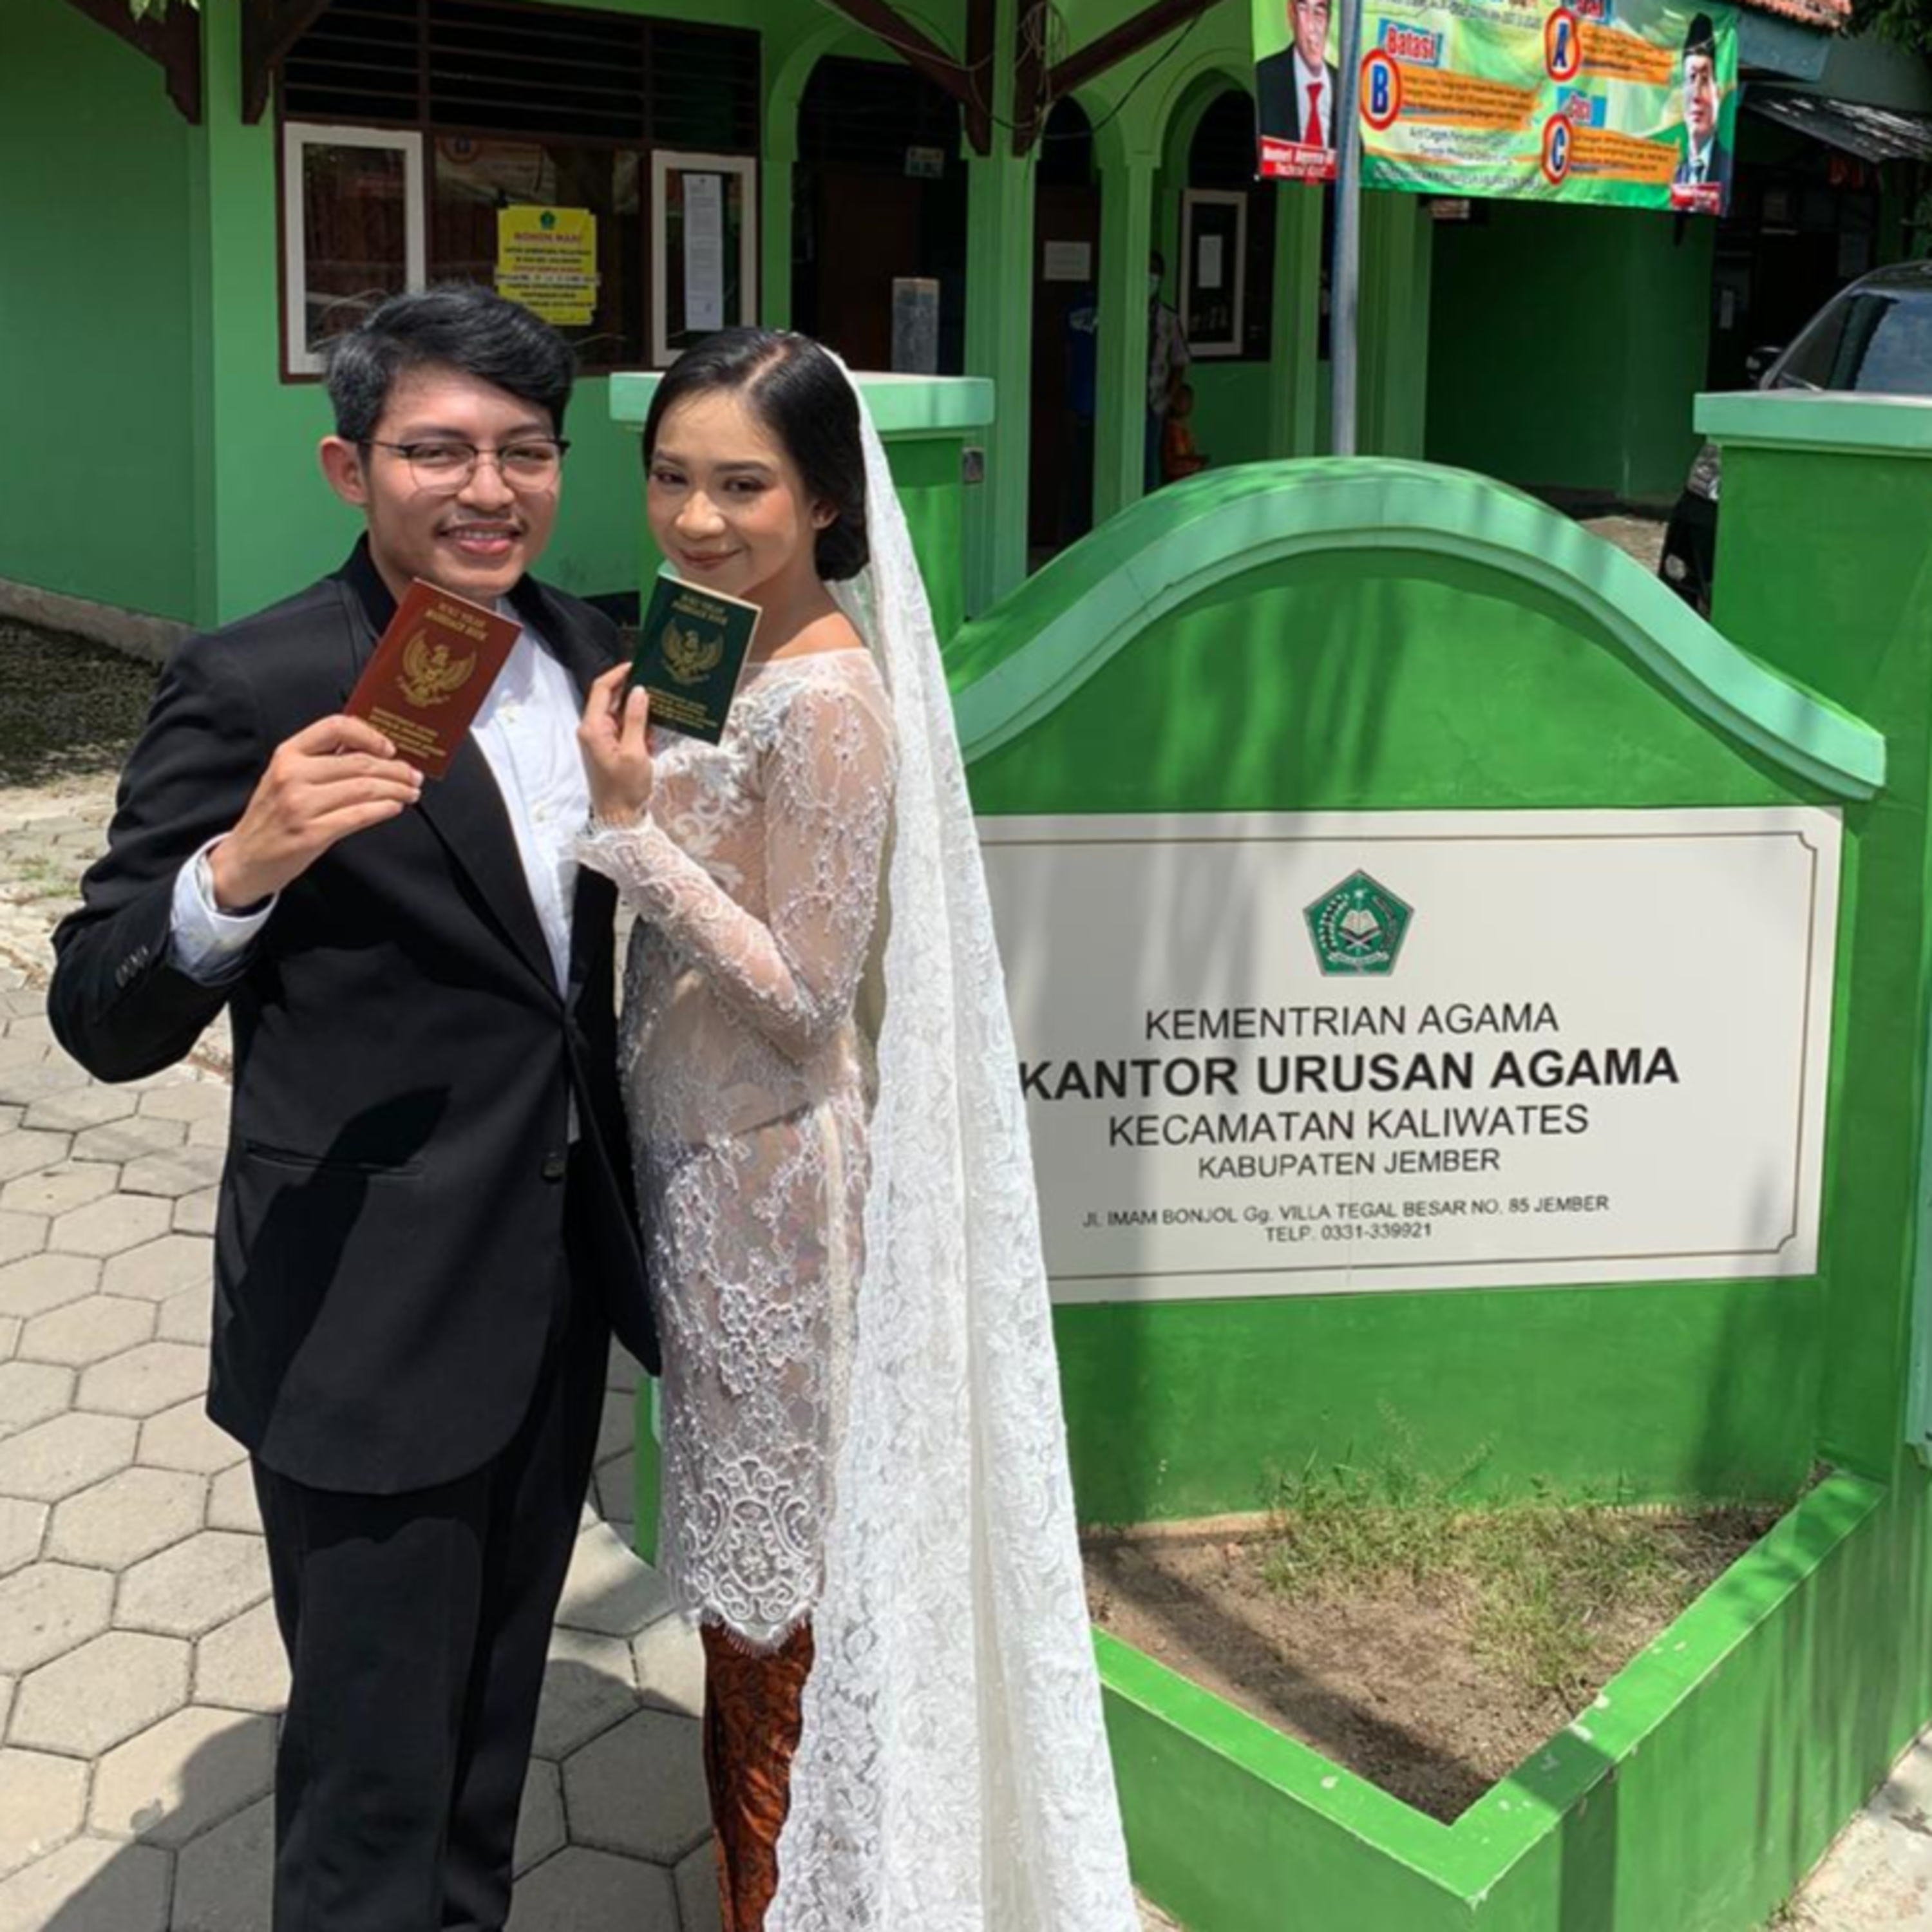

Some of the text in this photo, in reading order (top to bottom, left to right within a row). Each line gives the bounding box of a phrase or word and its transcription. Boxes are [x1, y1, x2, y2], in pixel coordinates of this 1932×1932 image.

[1386, 24, 1435, 59] Batasi
[1553, 23, 1569, 68] A
[1371, 64, 1388, 113] B
[1551, 127, 1566, 171] C
[1146, 1002, 1559, 1040] KEMENTRIAN AGAMA
[1019, 1046, 1679, 1100] KANTOR URUSAN AGAMA
[1110, 1104, 1589, 1146] KECAMATAN KALIWATES
[1198, 1148, 1500, 1179] KABUPATEN JEMBER
[1108, 1211, 1157, 1226] IMAM
[1162, 1207, 1237, 1225] BONJOL
[1279, 1204, 1331, 1221] VILLA
[1336, 1202, 1397, 1219] TEGAL
[1403, 1200, 1466, 1217] BESAR
[1472, 1198, 1504, 1215] NO.
[1509, 1197, 1530, 1213] 85
[1534, 1195, 1609, 1213] JEMBER
[1265, 1223, 1432, 1243] TELP. 0331-339921
